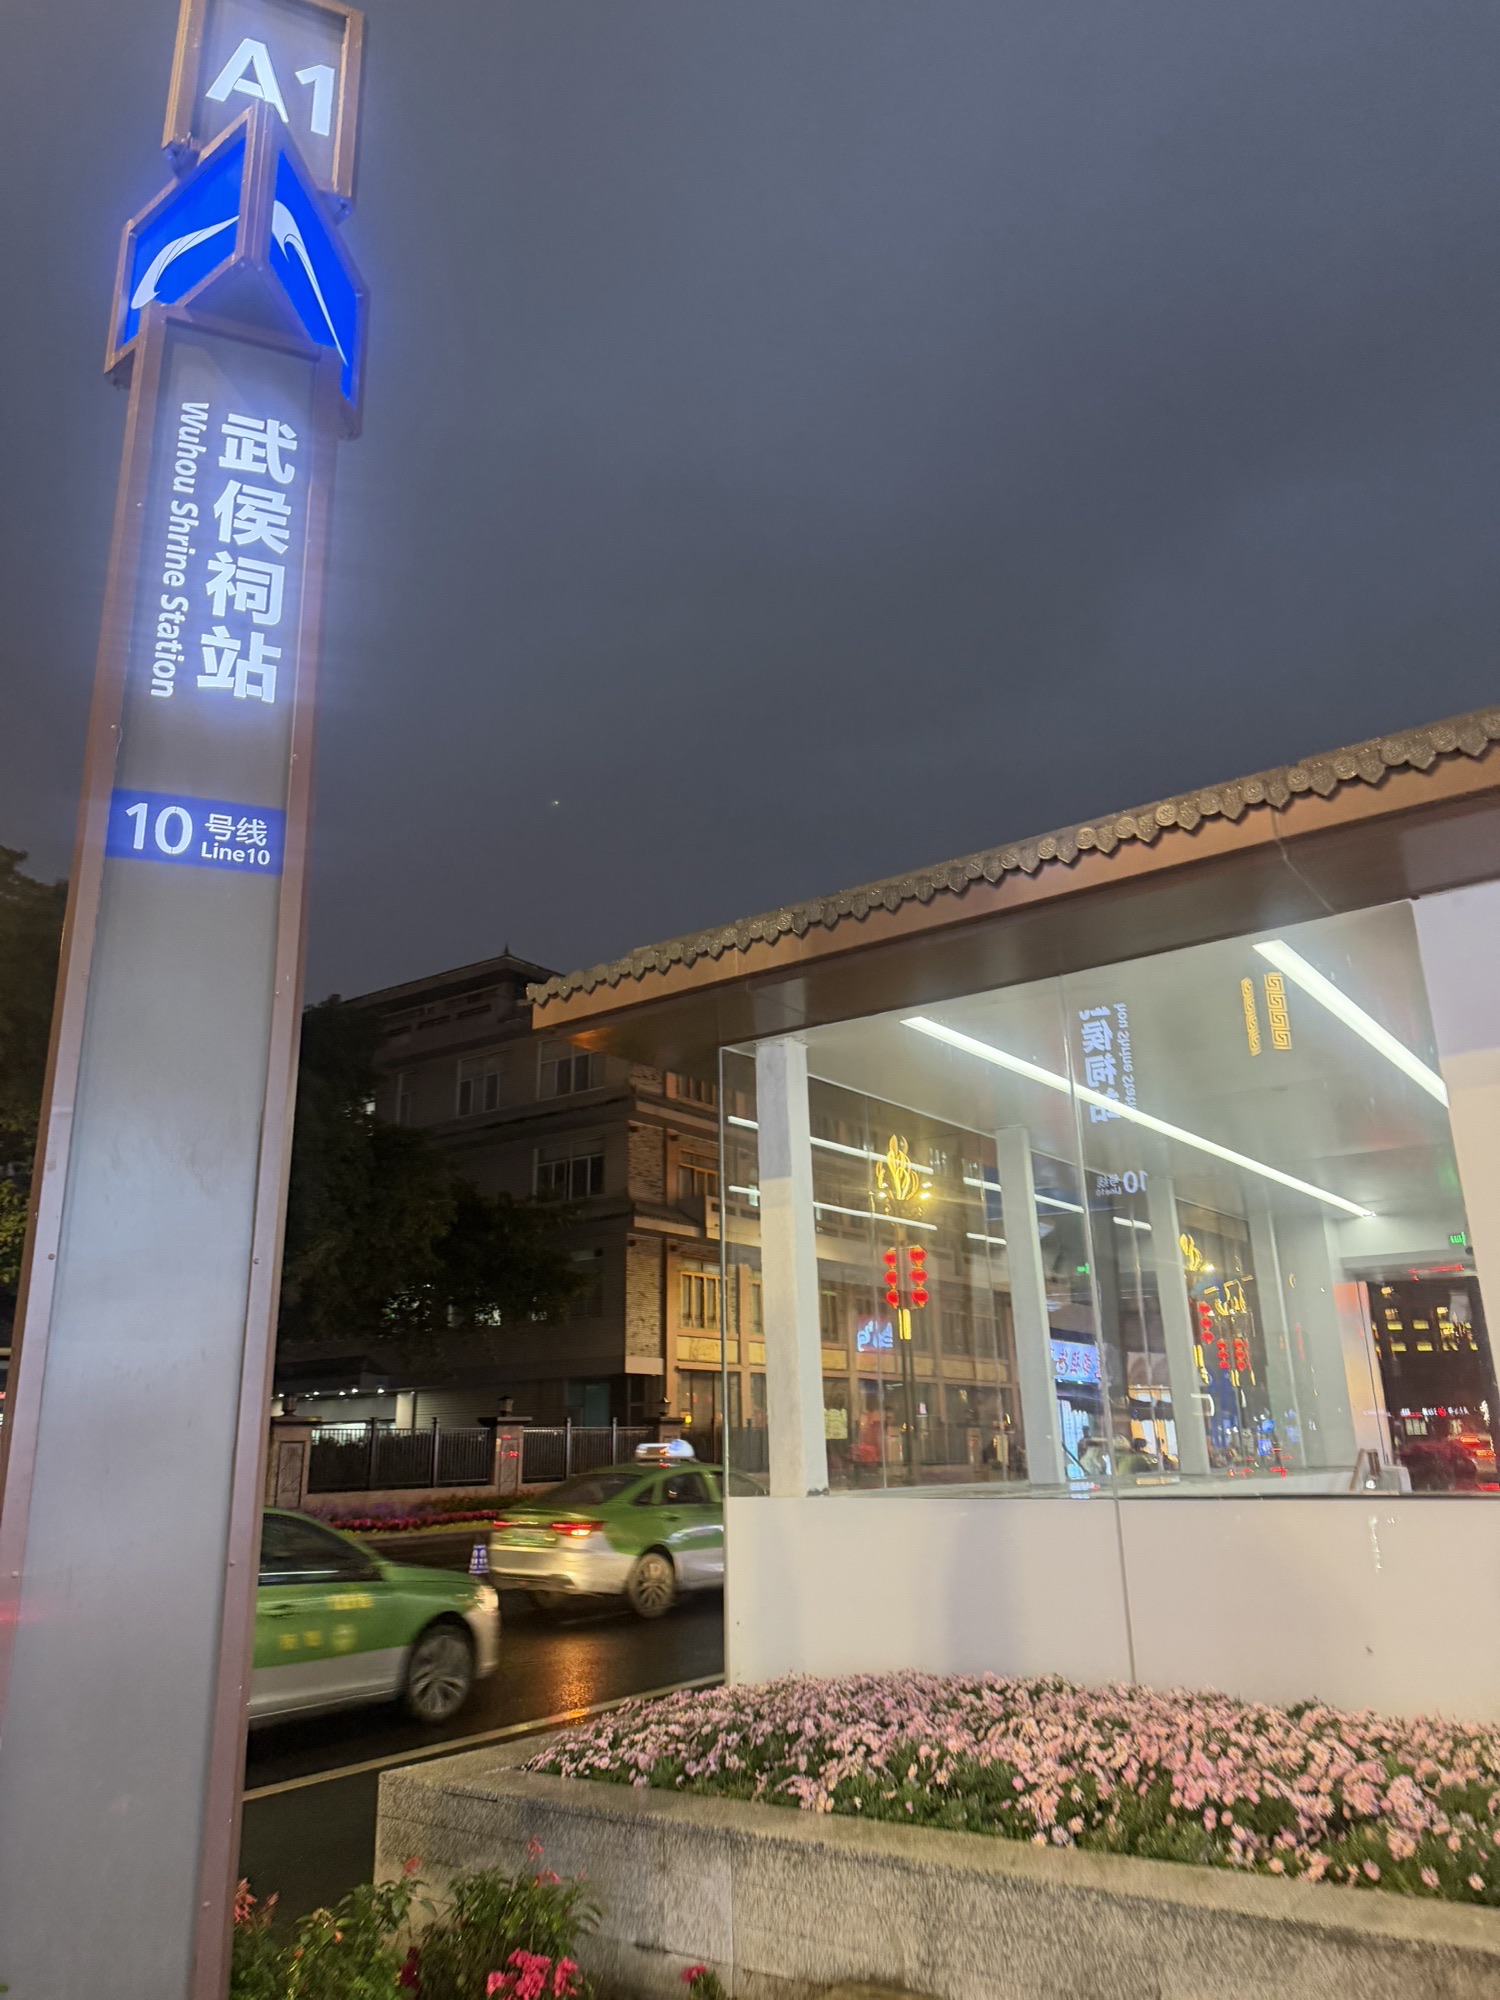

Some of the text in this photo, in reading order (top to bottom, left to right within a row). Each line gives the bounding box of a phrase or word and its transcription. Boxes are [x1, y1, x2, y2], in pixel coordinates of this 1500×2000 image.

[205, 37, 336, 136] A1
[150, 402, 210, 698] Wuhou Shrine Station
[197, 413, 298, 704] 武侯祠站
[125, 802, 193, 855] 10
